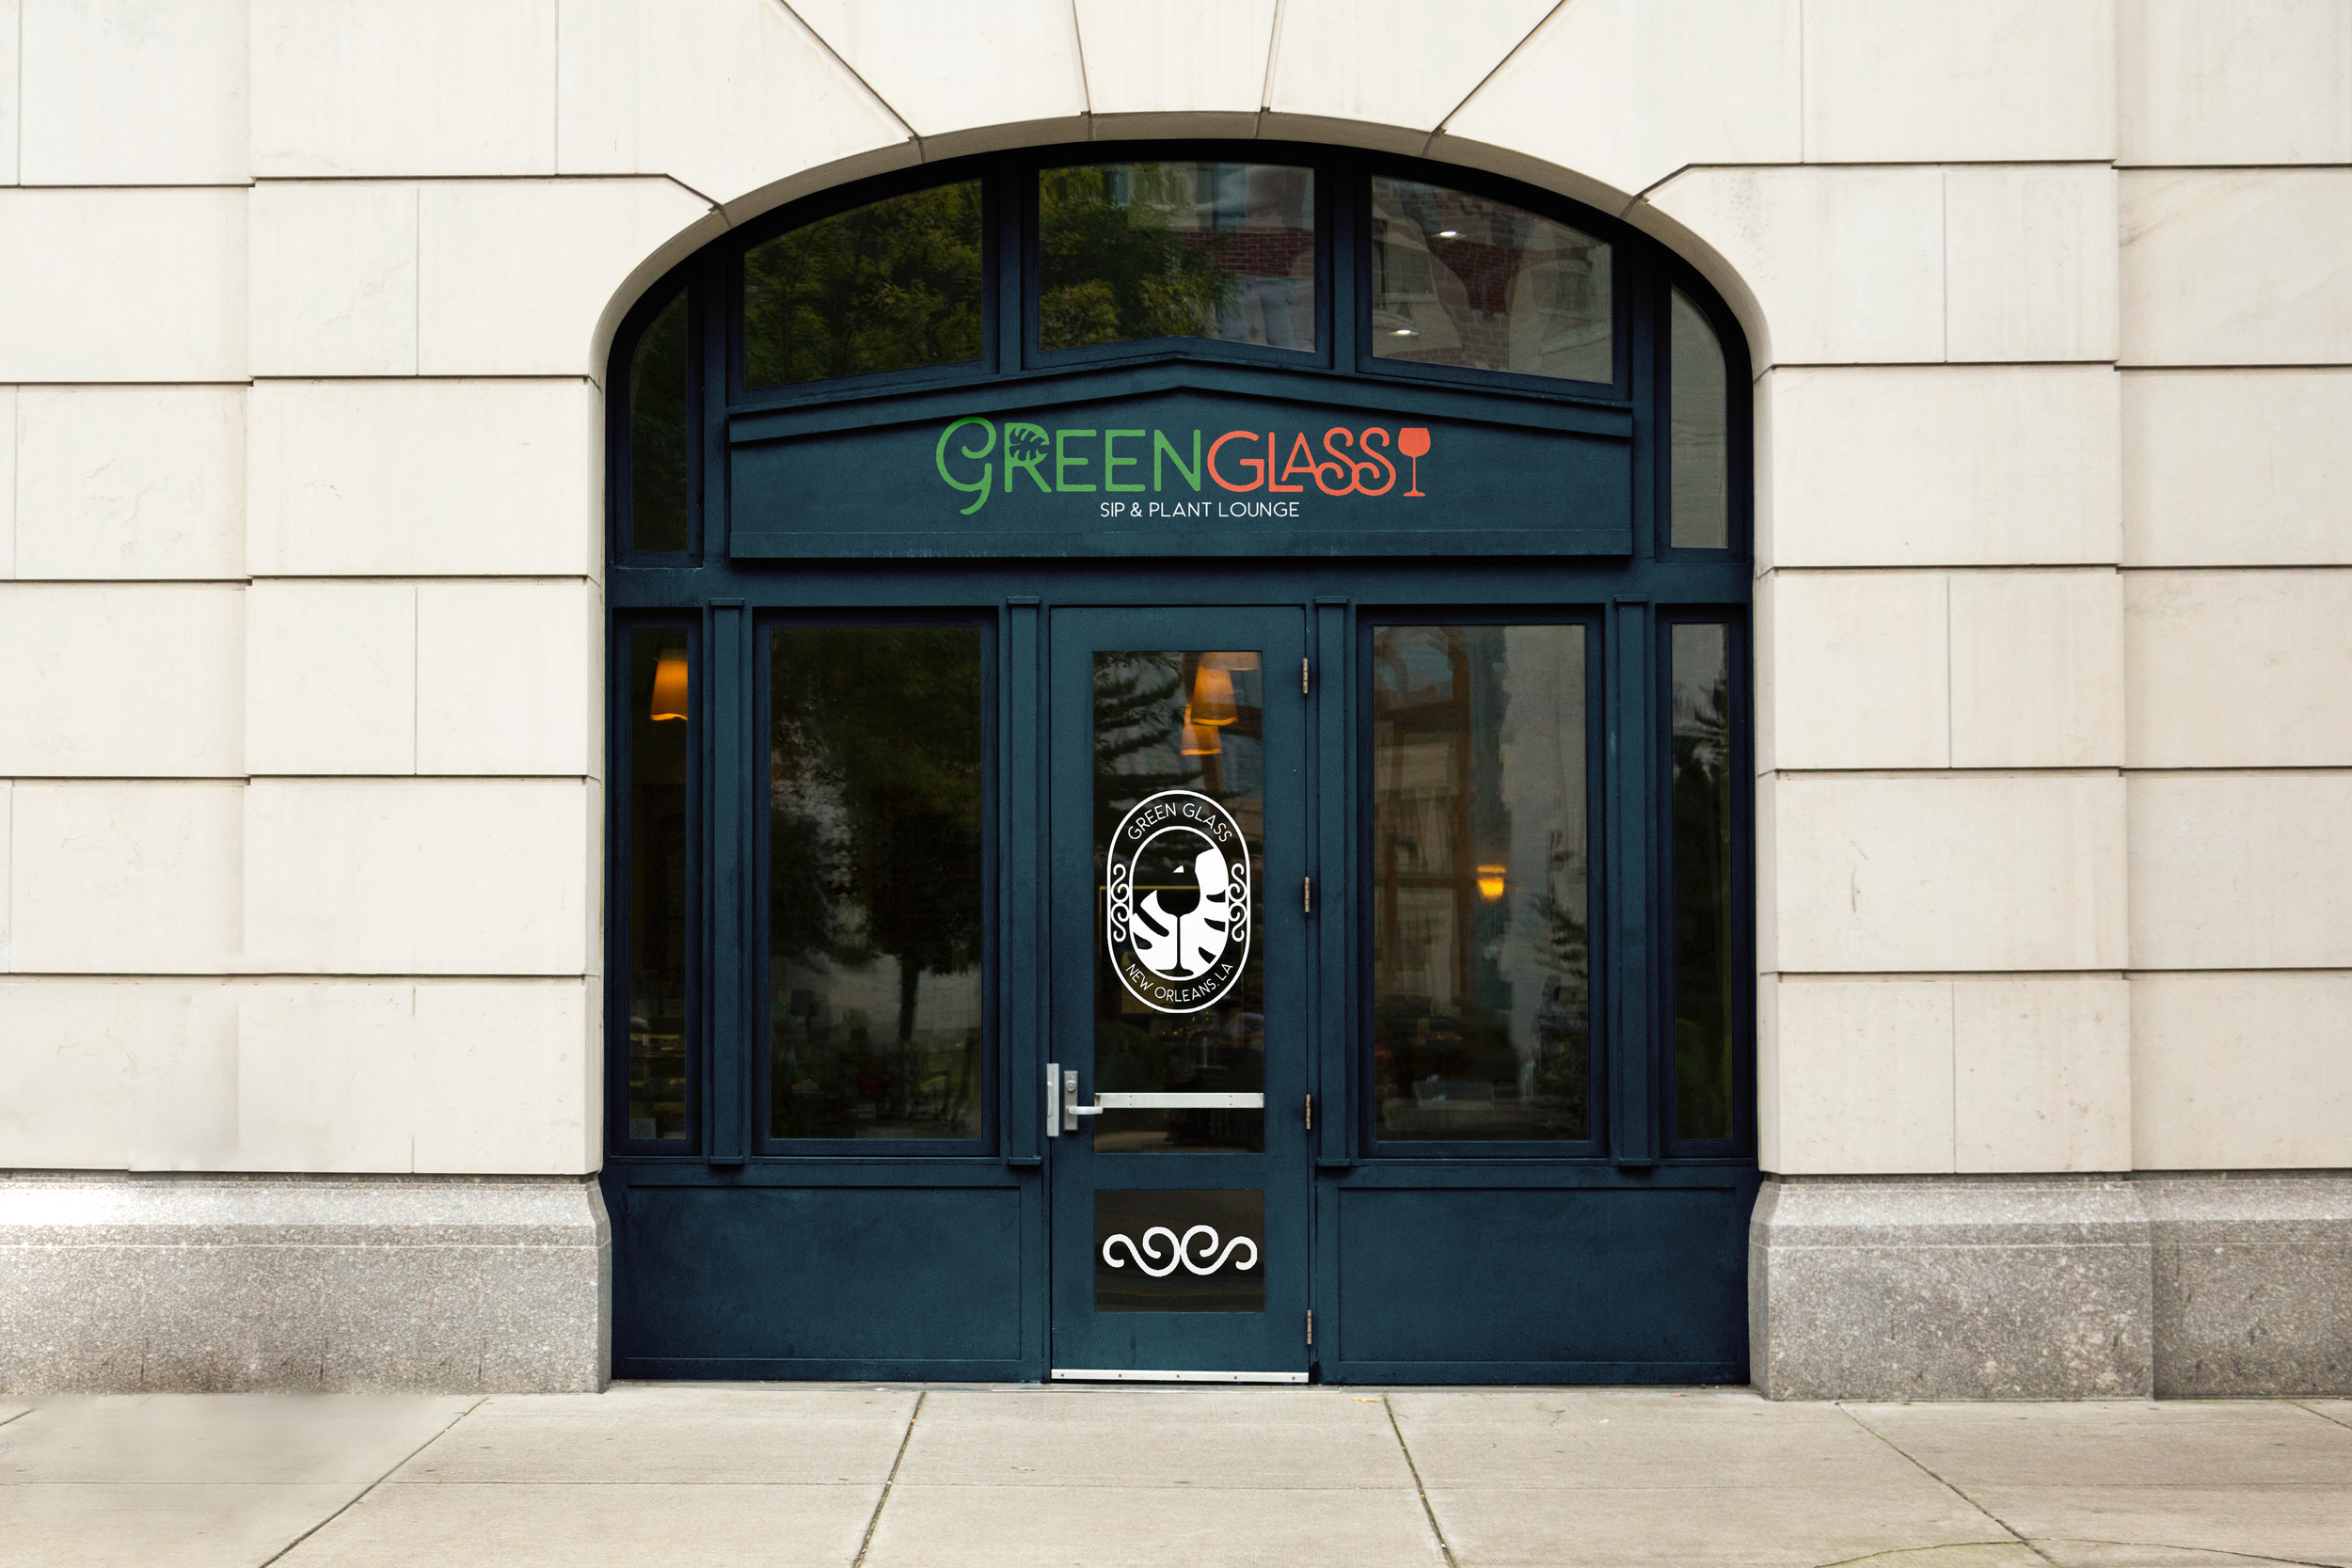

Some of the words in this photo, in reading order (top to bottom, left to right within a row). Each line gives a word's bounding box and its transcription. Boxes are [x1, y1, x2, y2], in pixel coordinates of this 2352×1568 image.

[1100, 501, 1125, 517] SIP
[1130, 501, 1143, 517] &
[1149, 501, 1213, 517] PLANT
[1218, 501, 1300, 517] LOUNGE
[1128, 802, 1176, 840] GREEN
[1183, 802, 1232, 842] GLASS
[1126, 963, 1154, 990] NEW
[1215, 963, 1233, 981] LA
